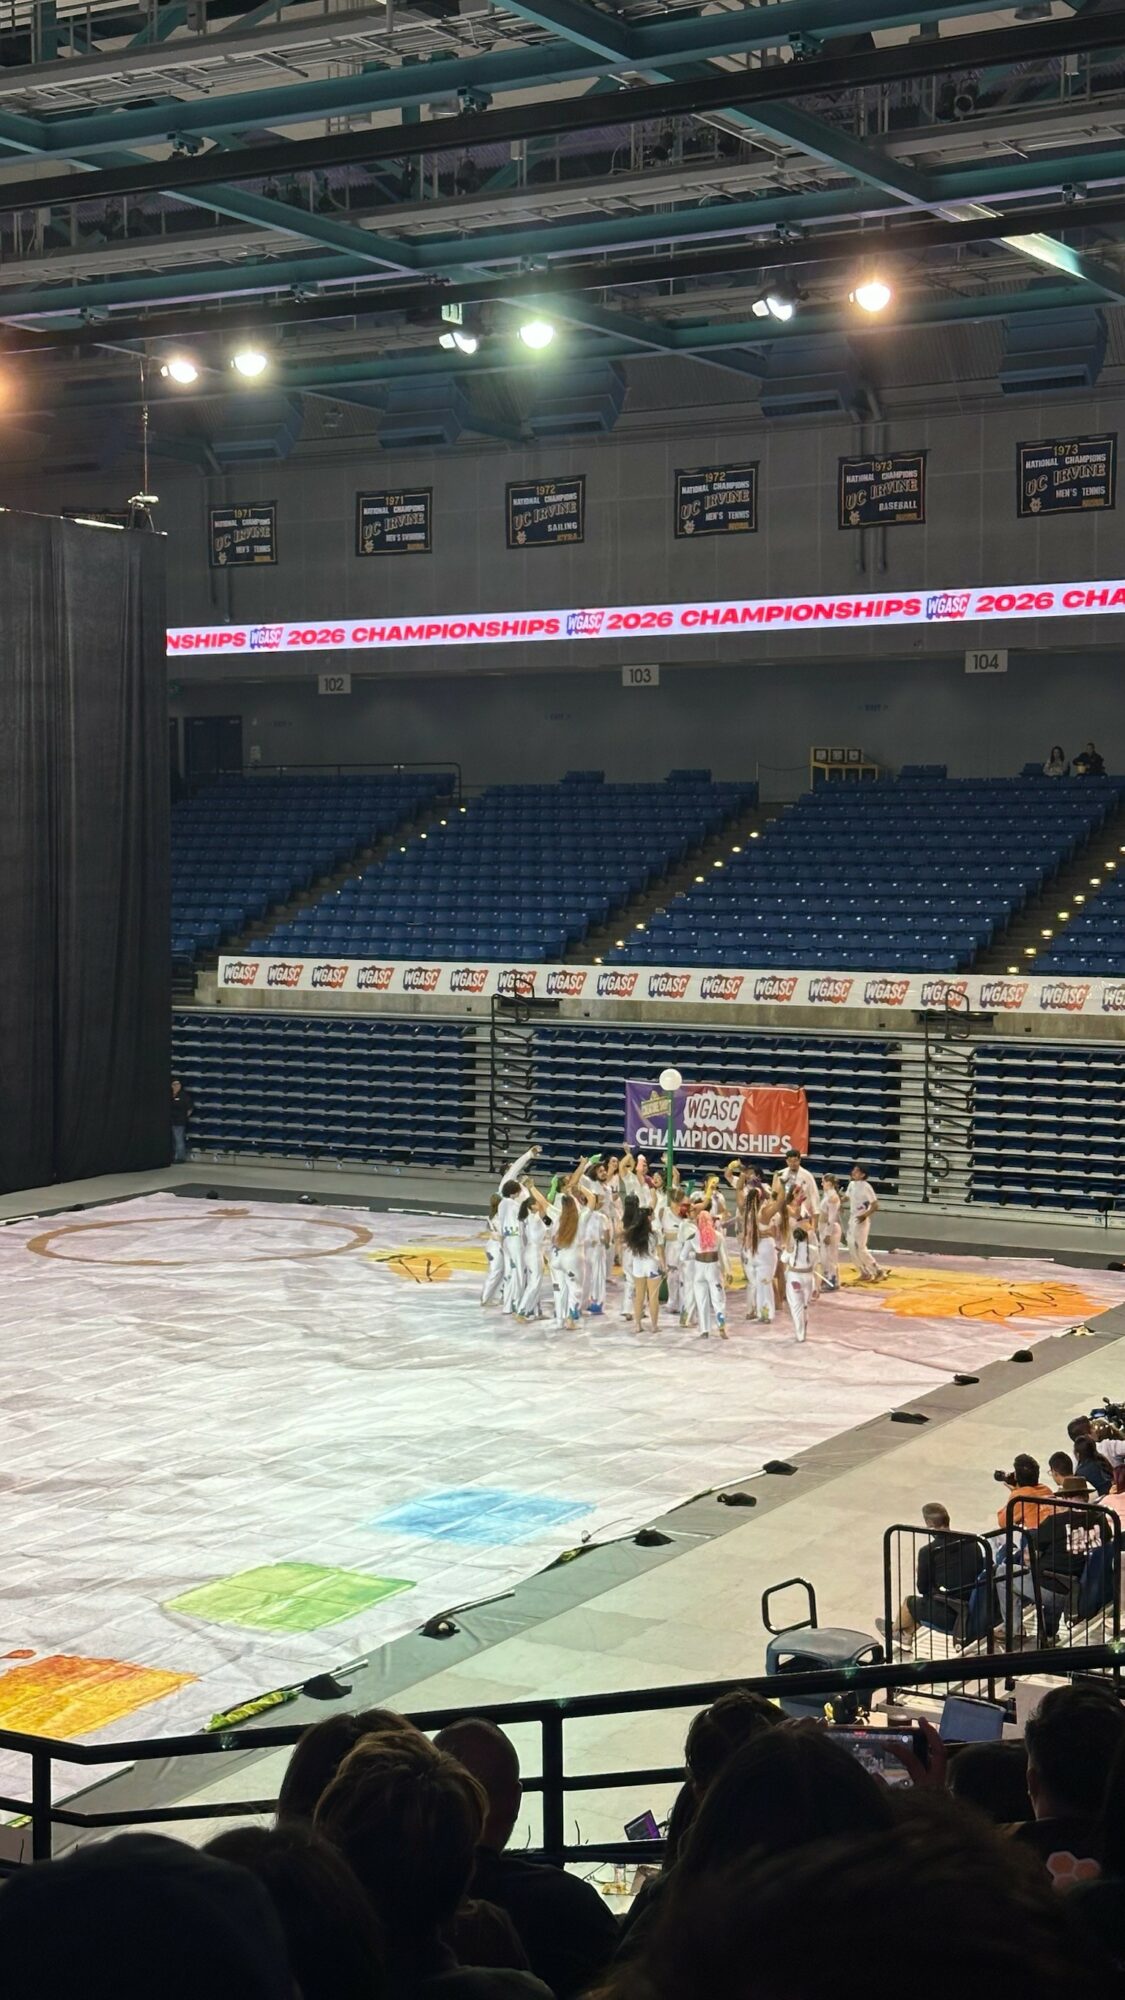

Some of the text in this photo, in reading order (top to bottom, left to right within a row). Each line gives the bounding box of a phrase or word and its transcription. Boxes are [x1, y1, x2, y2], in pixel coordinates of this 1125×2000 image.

[1053, 444, 1078, 456] 1973
[871, 460, 893, 471] 1973
[1026, 454, 1106, 469] NATIONAL CHAMPIONS
[705, 472, 726, 482] 1972
[846, 470, 918, 483] NATIONAL CHAMPIONS
[1025, 463, 1106, 497] UC IRVINE
[536, 485, 556, 495] 1972
[682, 481, 750, 495] NATIONAL CHAMPIONS
[846, 478, 918, 510] UC IRVINE
[1056, 486, 1106, 498] MEN'S TENNIS
[385, 496, 404, 505] 1971
[513, 493, 577, 505] NATIONAL CHAMPIONS
[681, 489, 750, 519] UC IRVINE
[879, 500, 917, 511] BASEBALL
[234, 509, 251, 518] 1971
[513, 501, 577, 530] UC IRVINE
[705, 510, 750, 521] MEN'S TENNIS
[363, 513, 425, 539] UC IRVINE
[548, 522, 577, 532] SAILING
[215, 526, 270, 551] UC IRVINE
[251, 629, 281, 646] WGASC
[287, 629, 345, 645] 2026
[351, 619, 560, 643] CHAMPIONSHIPS
[567, 614, 602, 631] WGASC
[607, 612, 673, 630] 2026
[681, 598, 921, 625] CHAMPIONSHIPS
[928, 597, 967, 614] WGASC
[975, 592, 1054, 612] 2026
[972, 654, 999, 669] 104
[629, 668, 651, 683] 103
[324, 678, 344, 691] 102
[225, 965, 257, 980] WGASC
[268, 967, 300, 981] WGASC
[313, 969, 345, 982] WGASC
[358, 970, 391, 984] WGASC
[404, 971, 437, 985] WGASC
[451, 972, 485, 987] WGASC
[548, 974, 584, 990] WGASC
[598, 975, 635, 991] WGASC
[650, 976, 687, 992] WGASC
[702, 979, 740, 994] WGASC
[755, 980, 794, 996] WGASC
[810, 981, 849, 997] WGASC
[866, 982, 906, 999] WGASC
[923, 985, 964, 1000] WGASC
[981, 985, 1025, 1002] WGASC
[1042, 986, 1085, 1004] WGASC
[688, 1098, 740, 1121] WGASC
